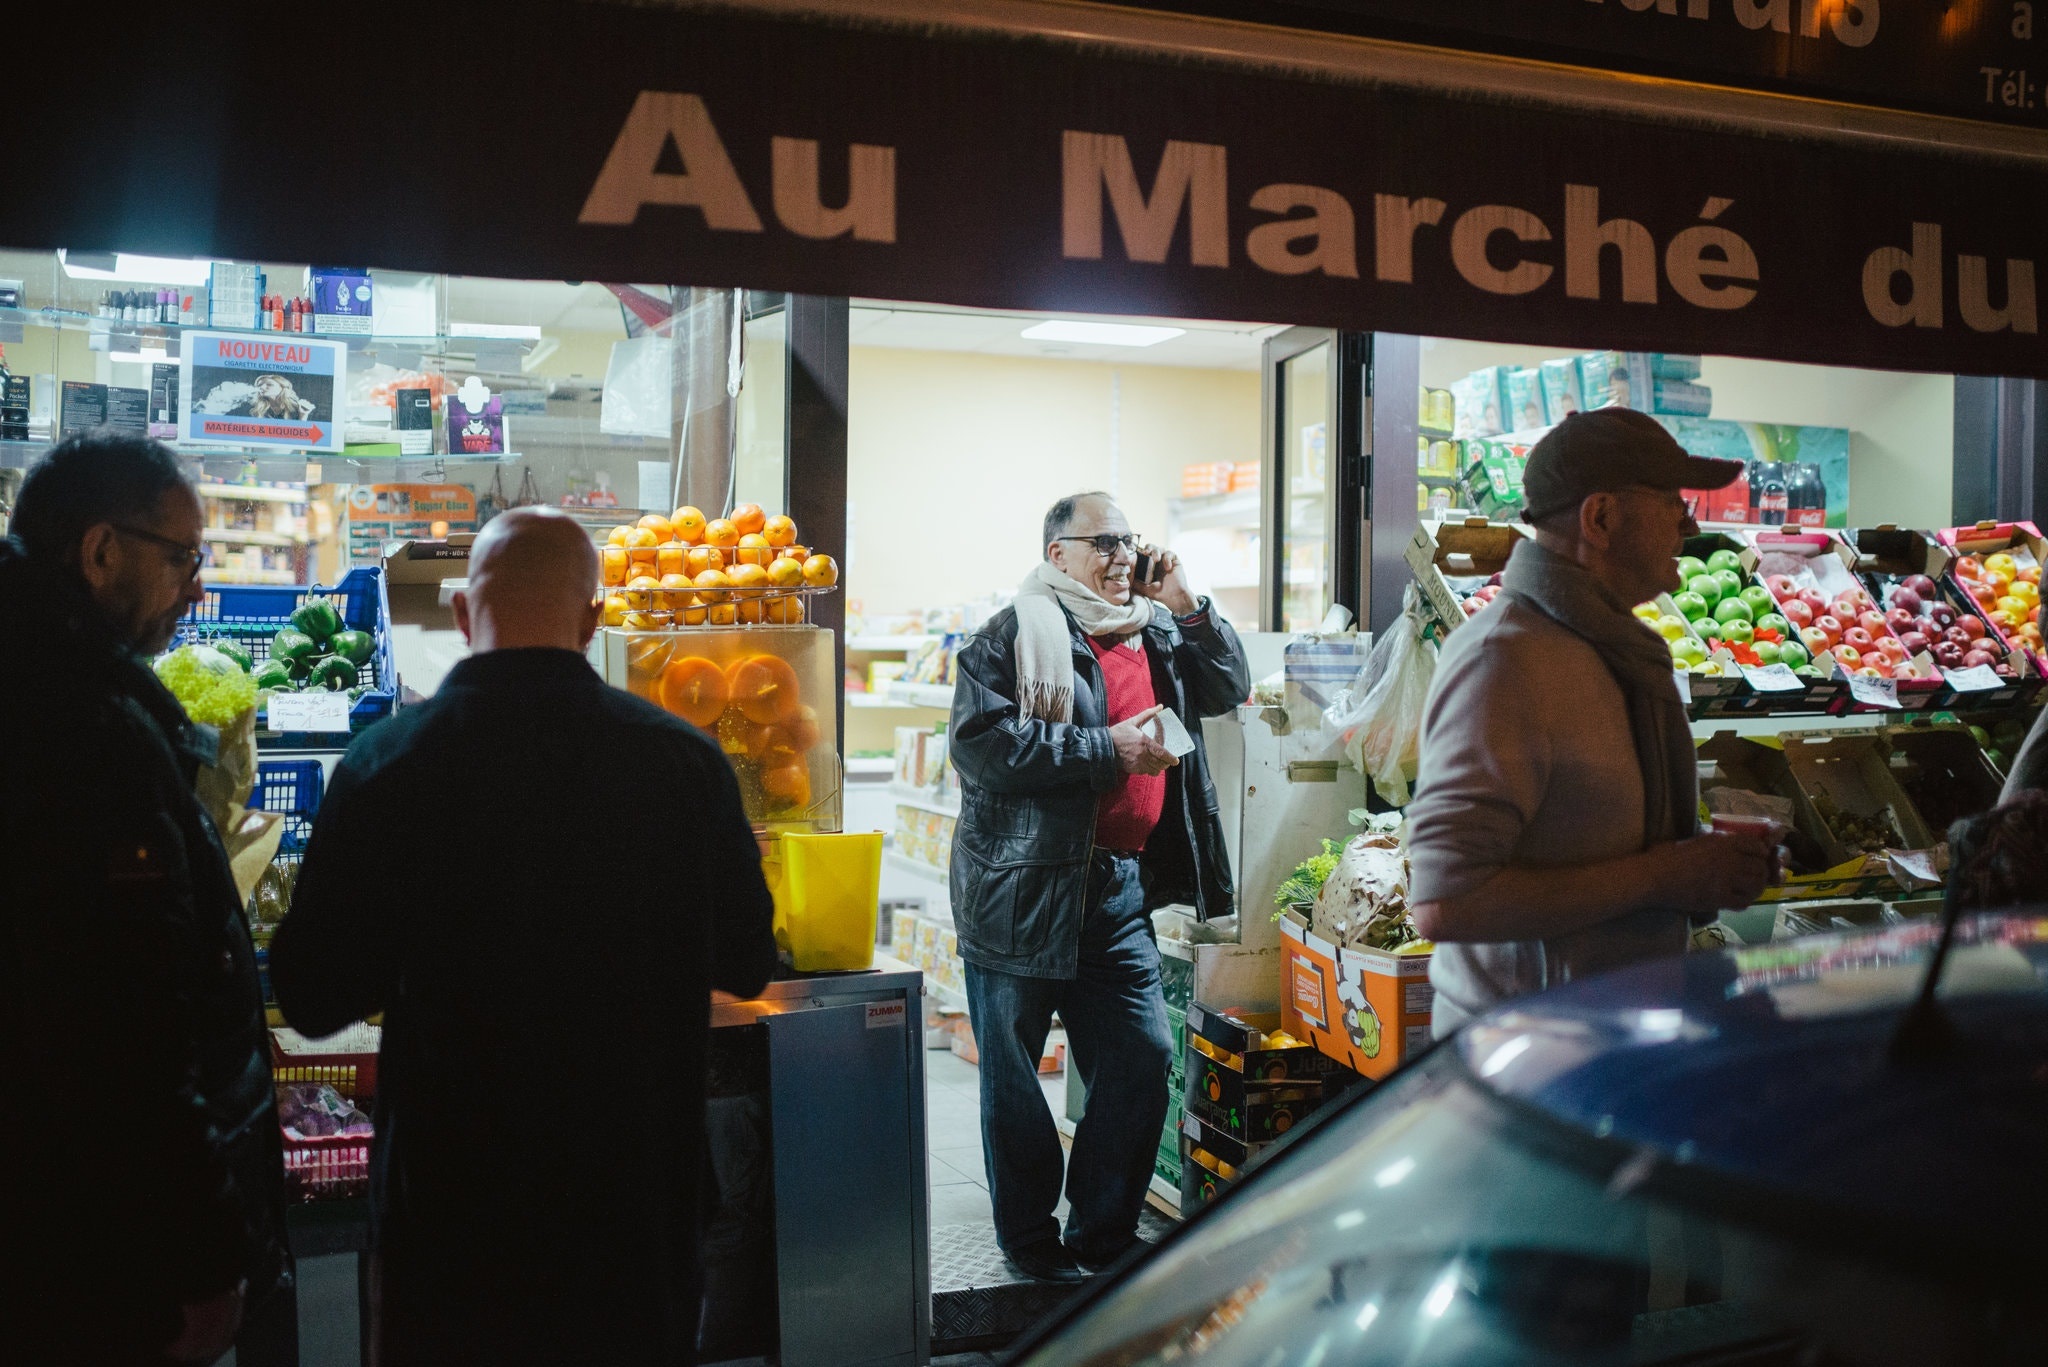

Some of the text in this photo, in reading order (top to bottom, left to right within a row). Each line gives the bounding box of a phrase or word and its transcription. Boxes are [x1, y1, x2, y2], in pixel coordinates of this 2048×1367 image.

[1980, 66, 2036, 109] Tél:
[577, 91, 2038, 334] Au Marché du
[218, 340, 311, 364] NOUVEAU
[224, 360, 257, 369] CIGARETTE
[205, 422, 310, 438] MATÉRIELS & LIQUIDES
[868, 1005, 904, 1017] ZUMMO
